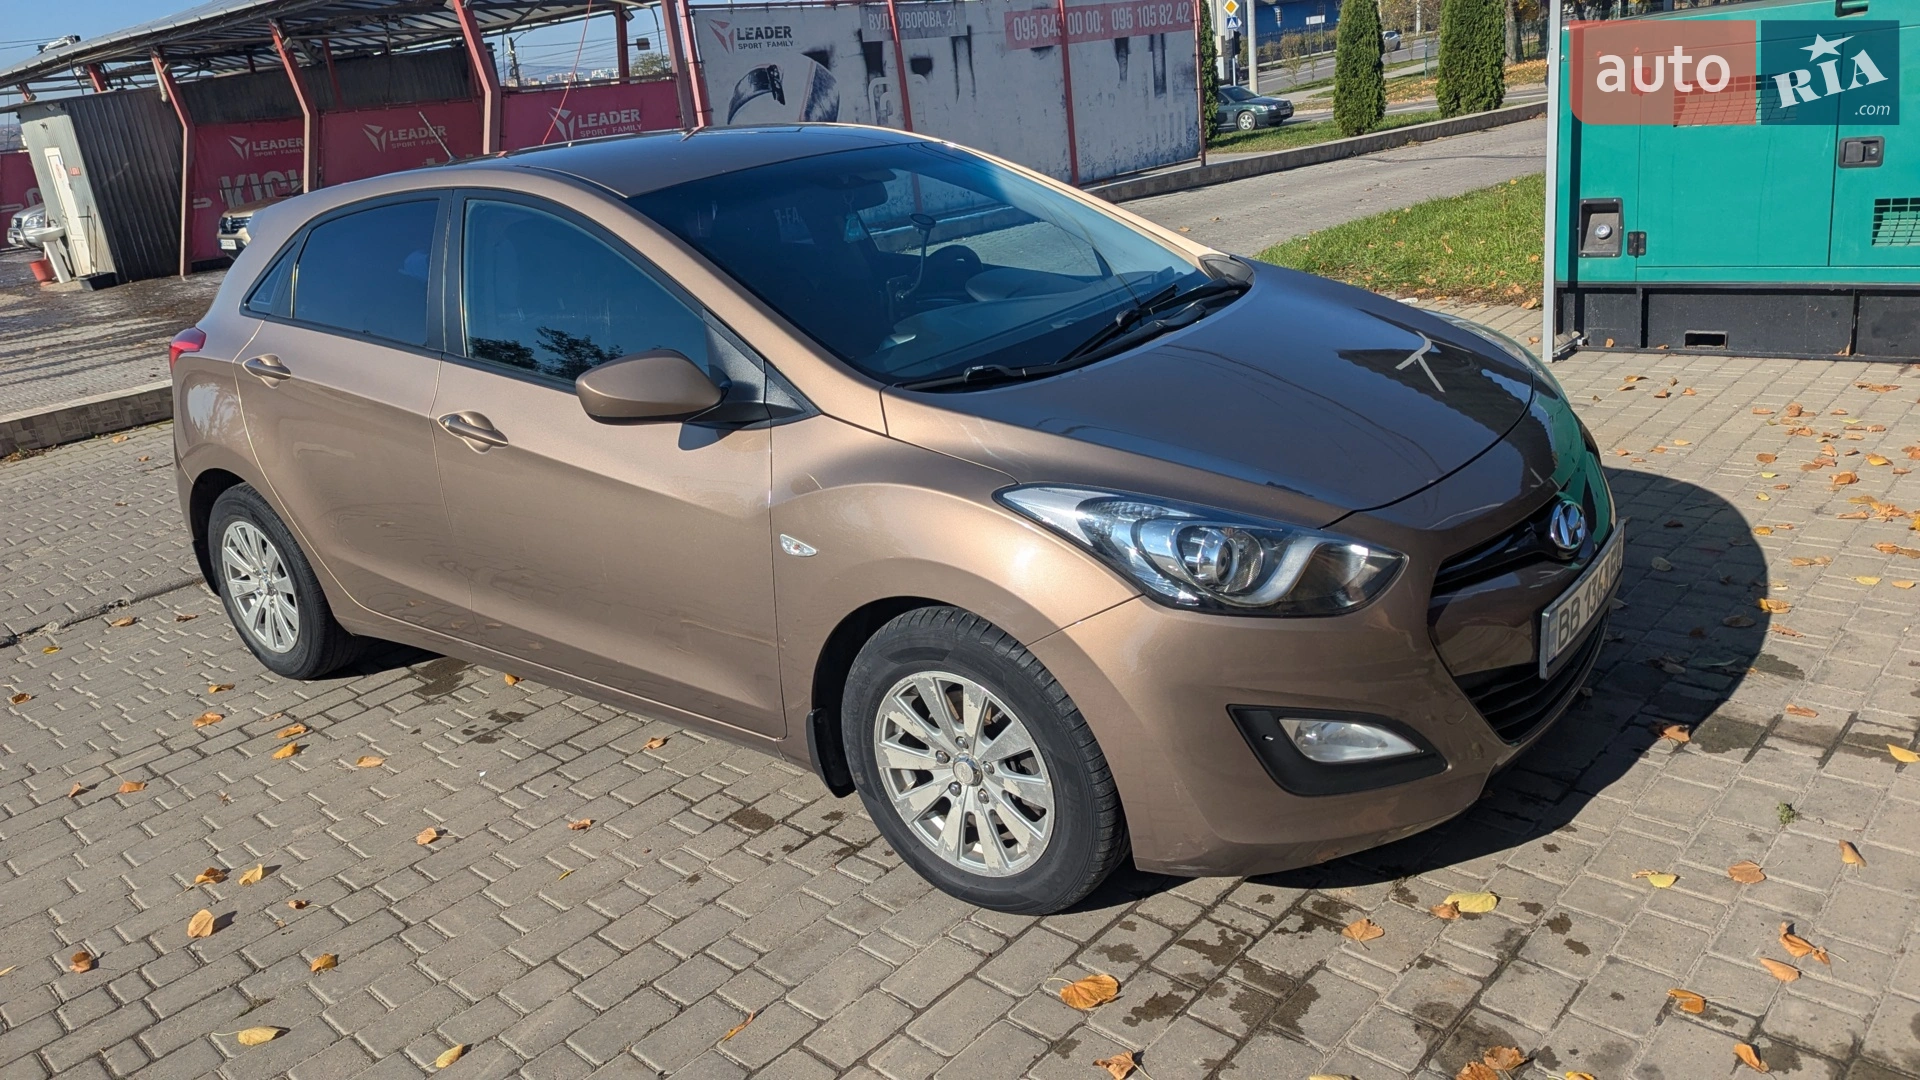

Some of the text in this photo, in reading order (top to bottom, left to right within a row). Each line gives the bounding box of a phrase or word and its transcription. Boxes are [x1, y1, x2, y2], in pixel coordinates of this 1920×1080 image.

[1013, 15, 1038, 41] 095
[1067, 11, 1083, 35] 00
[1085, 10, 1104, 35] 00;
[1111, 6, 1133, 31] 095
[1137, 4, 1157, 28] 105
[1160, 3, 1173, 26] 82
[1176, 1, 1191, 24] 42
[736, 25, 793, 41] LEADER
[738, 40, 794, 50] SPORT FAMILY
[578, 109, 641, 129] LEADER
[389, 125, 448, 142] LEADER
[580, 123, 642, 138] SPORT FAMILY
[252, 137, 304, 151] LEADER
[391, 141, 417, 149] SPORT
[1557, 597, 1580, 651] BB
